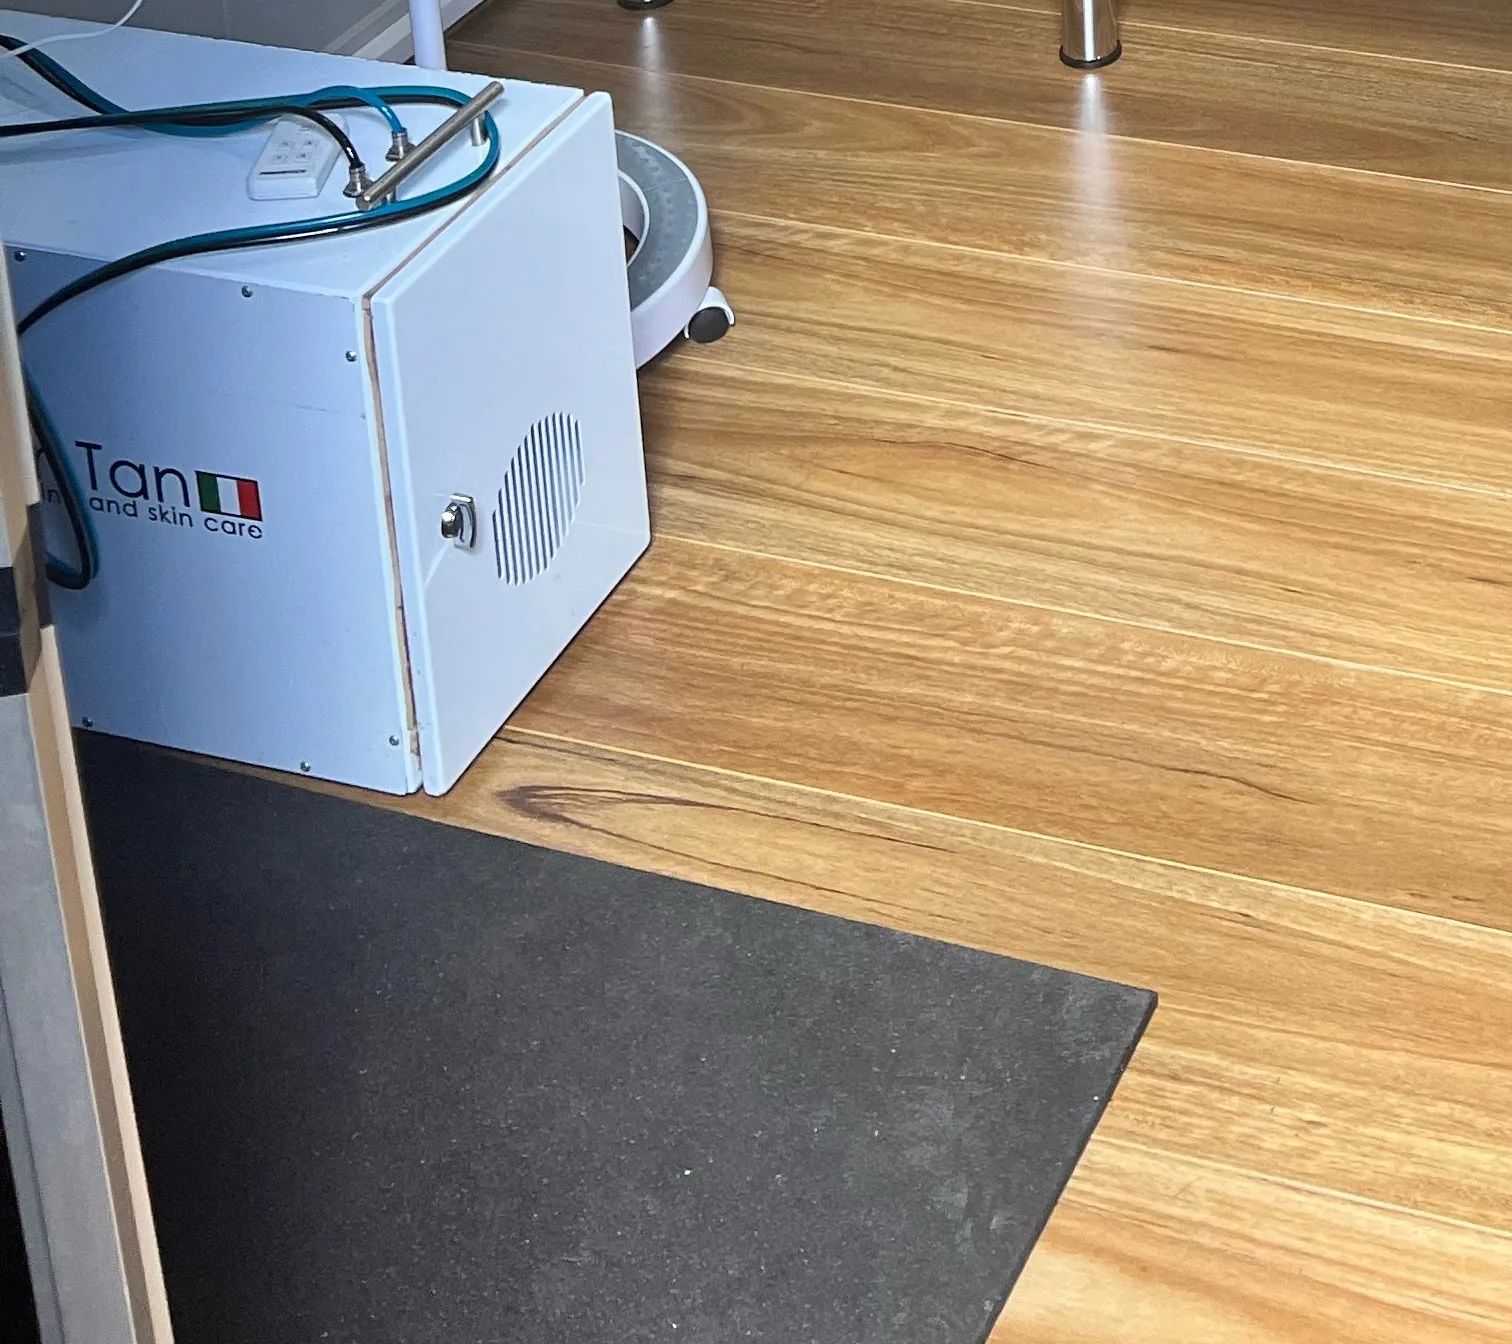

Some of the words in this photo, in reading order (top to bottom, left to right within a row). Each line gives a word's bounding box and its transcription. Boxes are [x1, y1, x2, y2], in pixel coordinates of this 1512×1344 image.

[75, 440, 191, 508] Tan
[89, 496, 138, 518] and
[148, 503, 194, 528] skin
[204, 517, 263, 540] care
